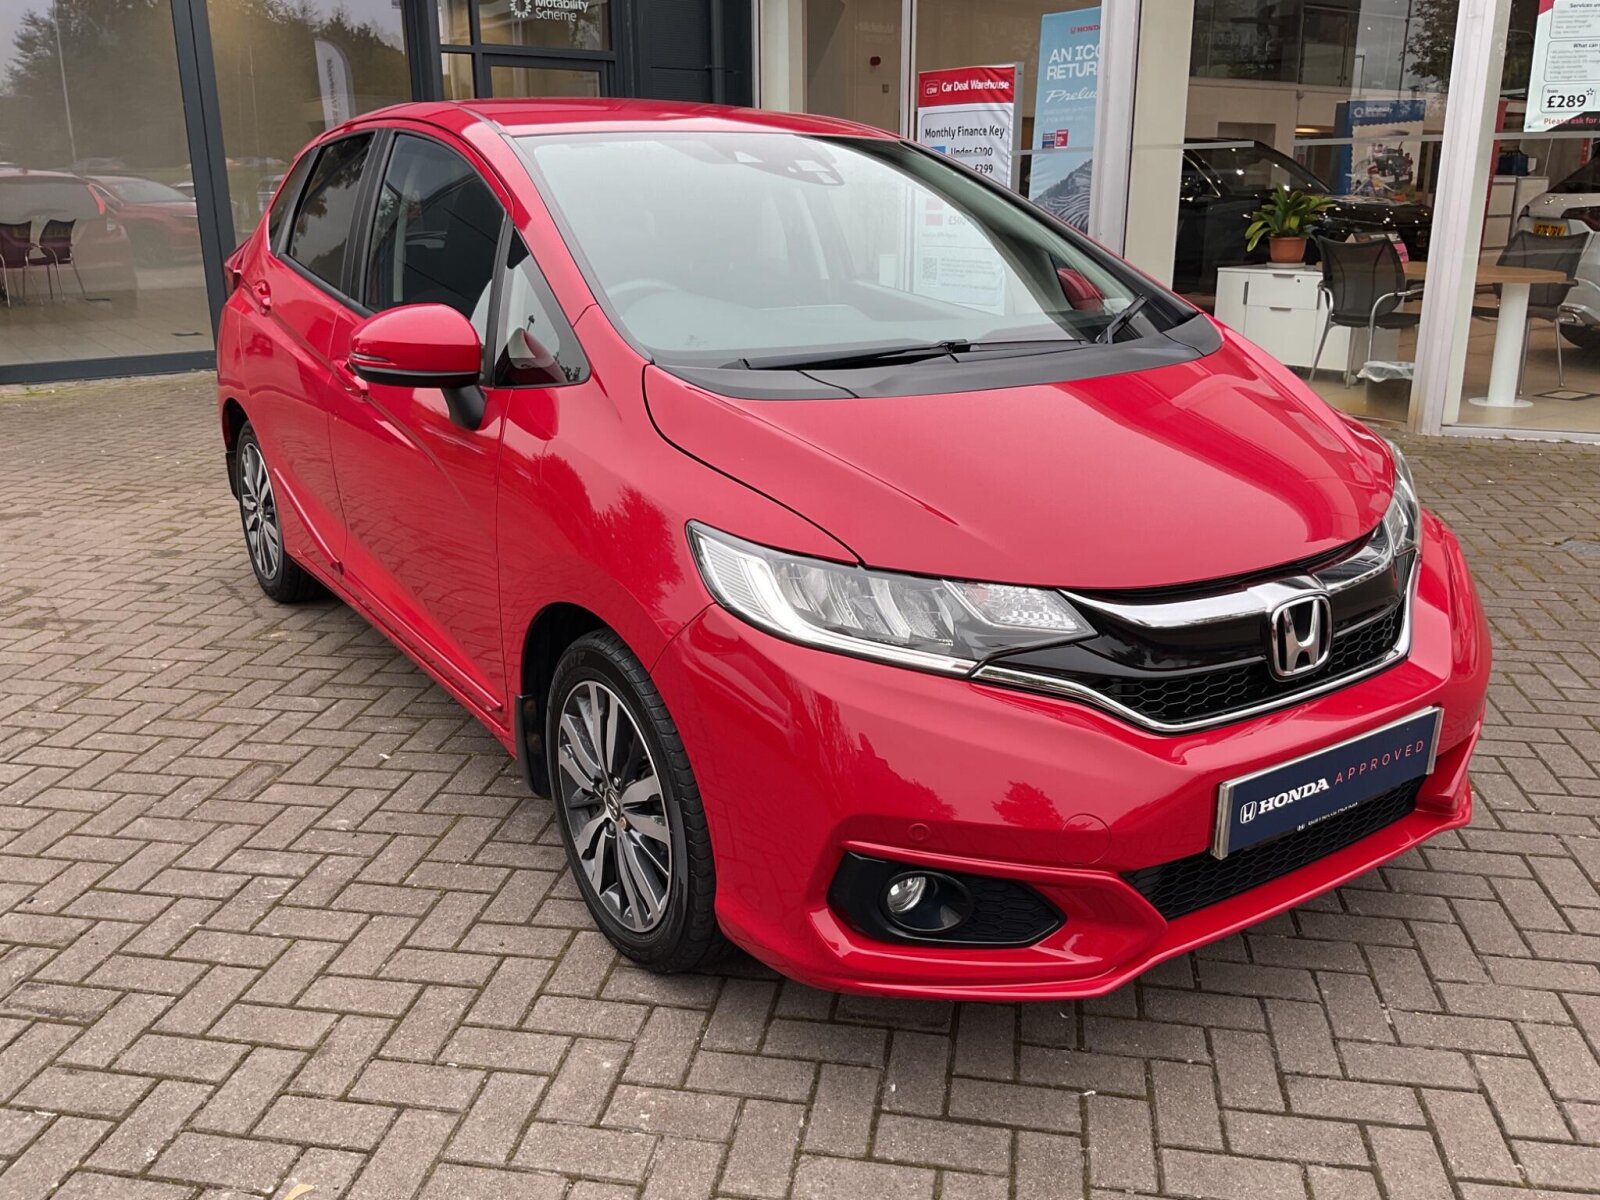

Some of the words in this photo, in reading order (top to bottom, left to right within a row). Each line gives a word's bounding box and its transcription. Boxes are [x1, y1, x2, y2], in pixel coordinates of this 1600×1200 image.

[535, 0, 589, 13] Motability
[535, 7, 577, 21] Scheme
[1077, 24, 1100, 32] HOND
[1048, 47, 1072, 64] AN
[941, 82, 953, 92] Car
[953, 80, 969, 91] Deal
[970, 79, 1009, 90] Warehouse
[1547, 94, 1586, 108] £289
[1544, 117, 1568, 125] Please
[1571, 116, 1583, 124] ask
[1586, 116, 1597, 124] for
[925, 126, 956, 140] Monthly
[957, 124, 987, 136] Finance
[989, 124, 1005, 139] Key
[1258, 778, 1330, 814] HONDA
[1335, 740, 1424, 785] APPROVED
